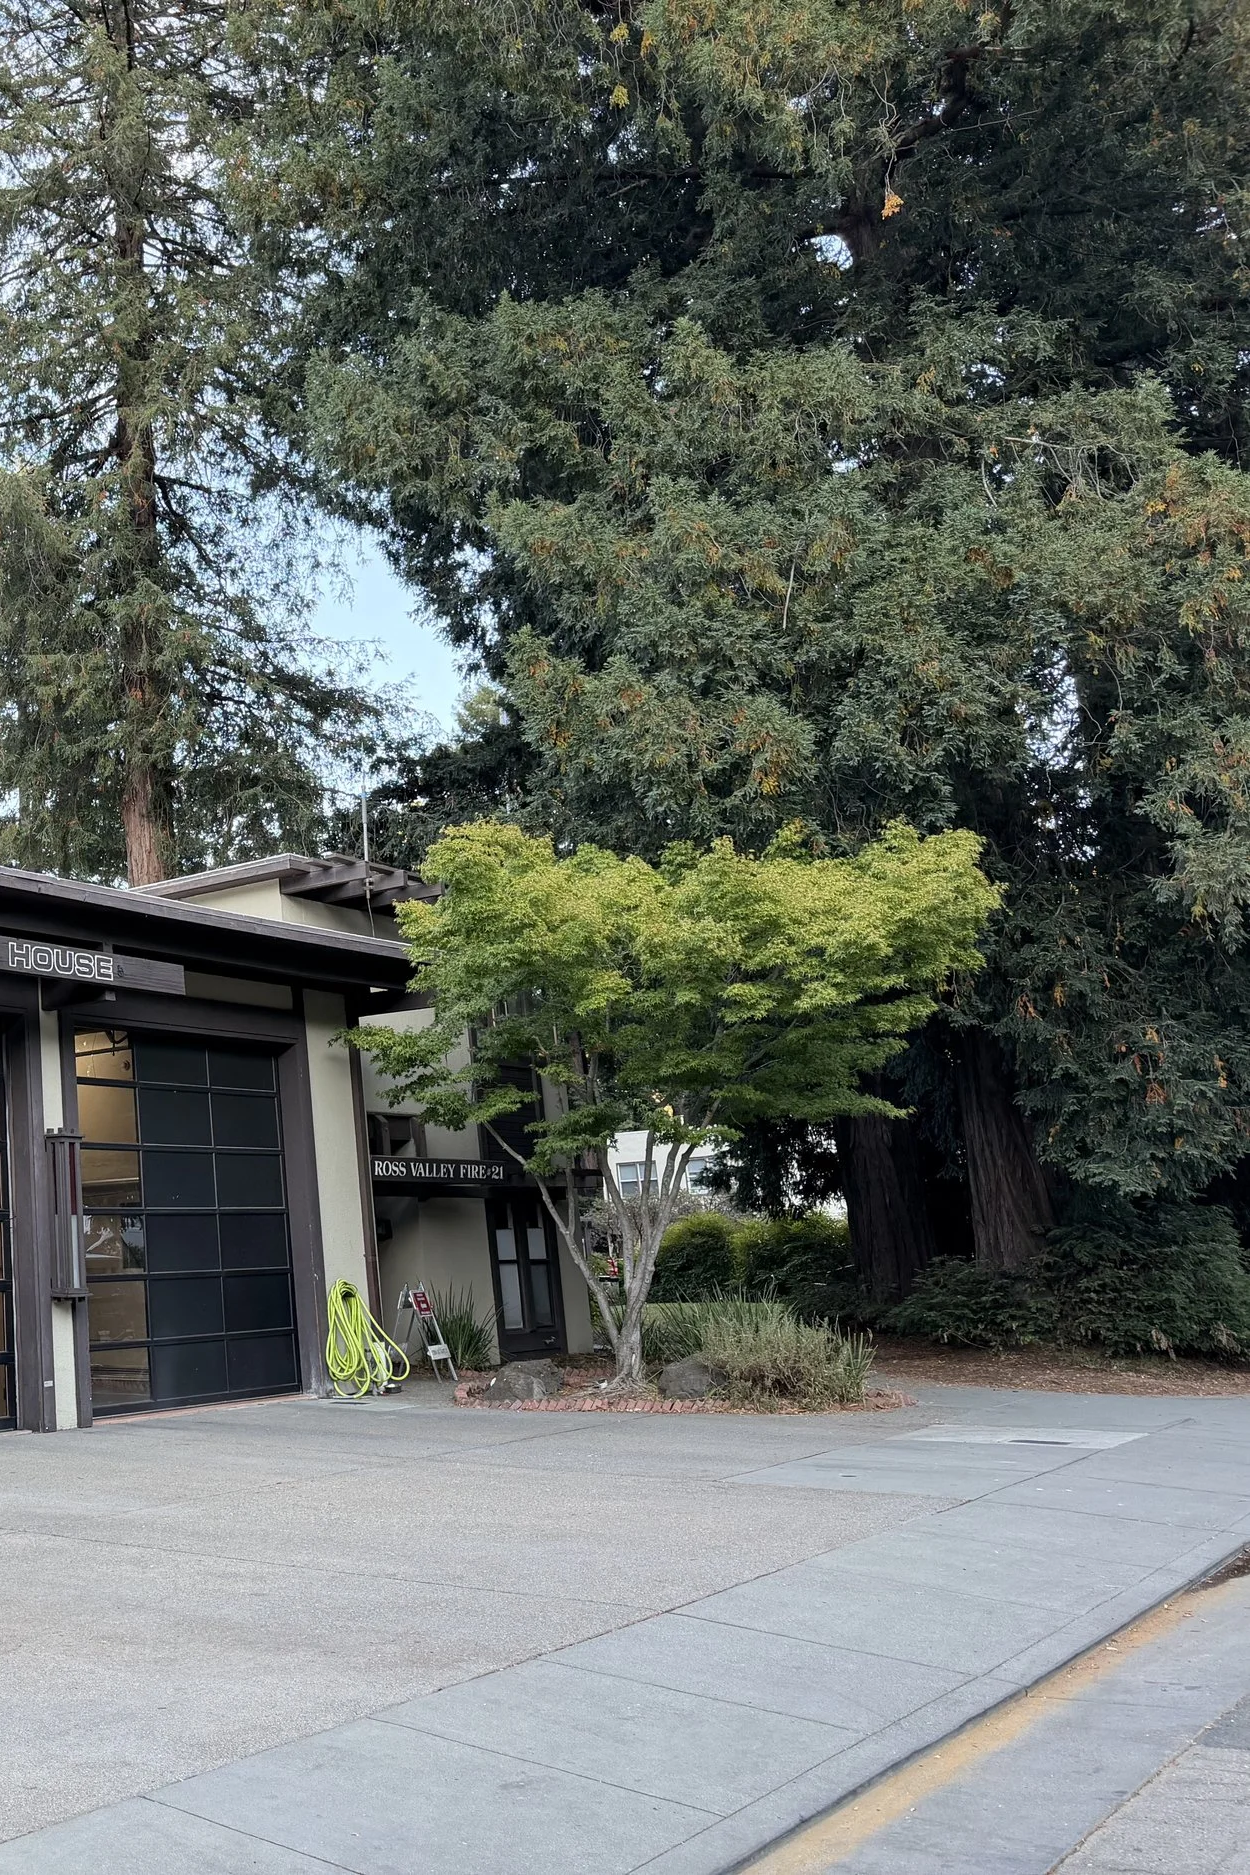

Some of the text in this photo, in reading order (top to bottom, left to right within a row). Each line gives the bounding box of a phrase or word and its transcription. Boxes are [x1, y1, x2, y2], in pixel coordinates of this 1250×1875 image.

[9, 942, 113, 981] HOUSE
[374, 1160, 407, 1177] ROSS
[410, 1162, 456, 1178] VALLEY
